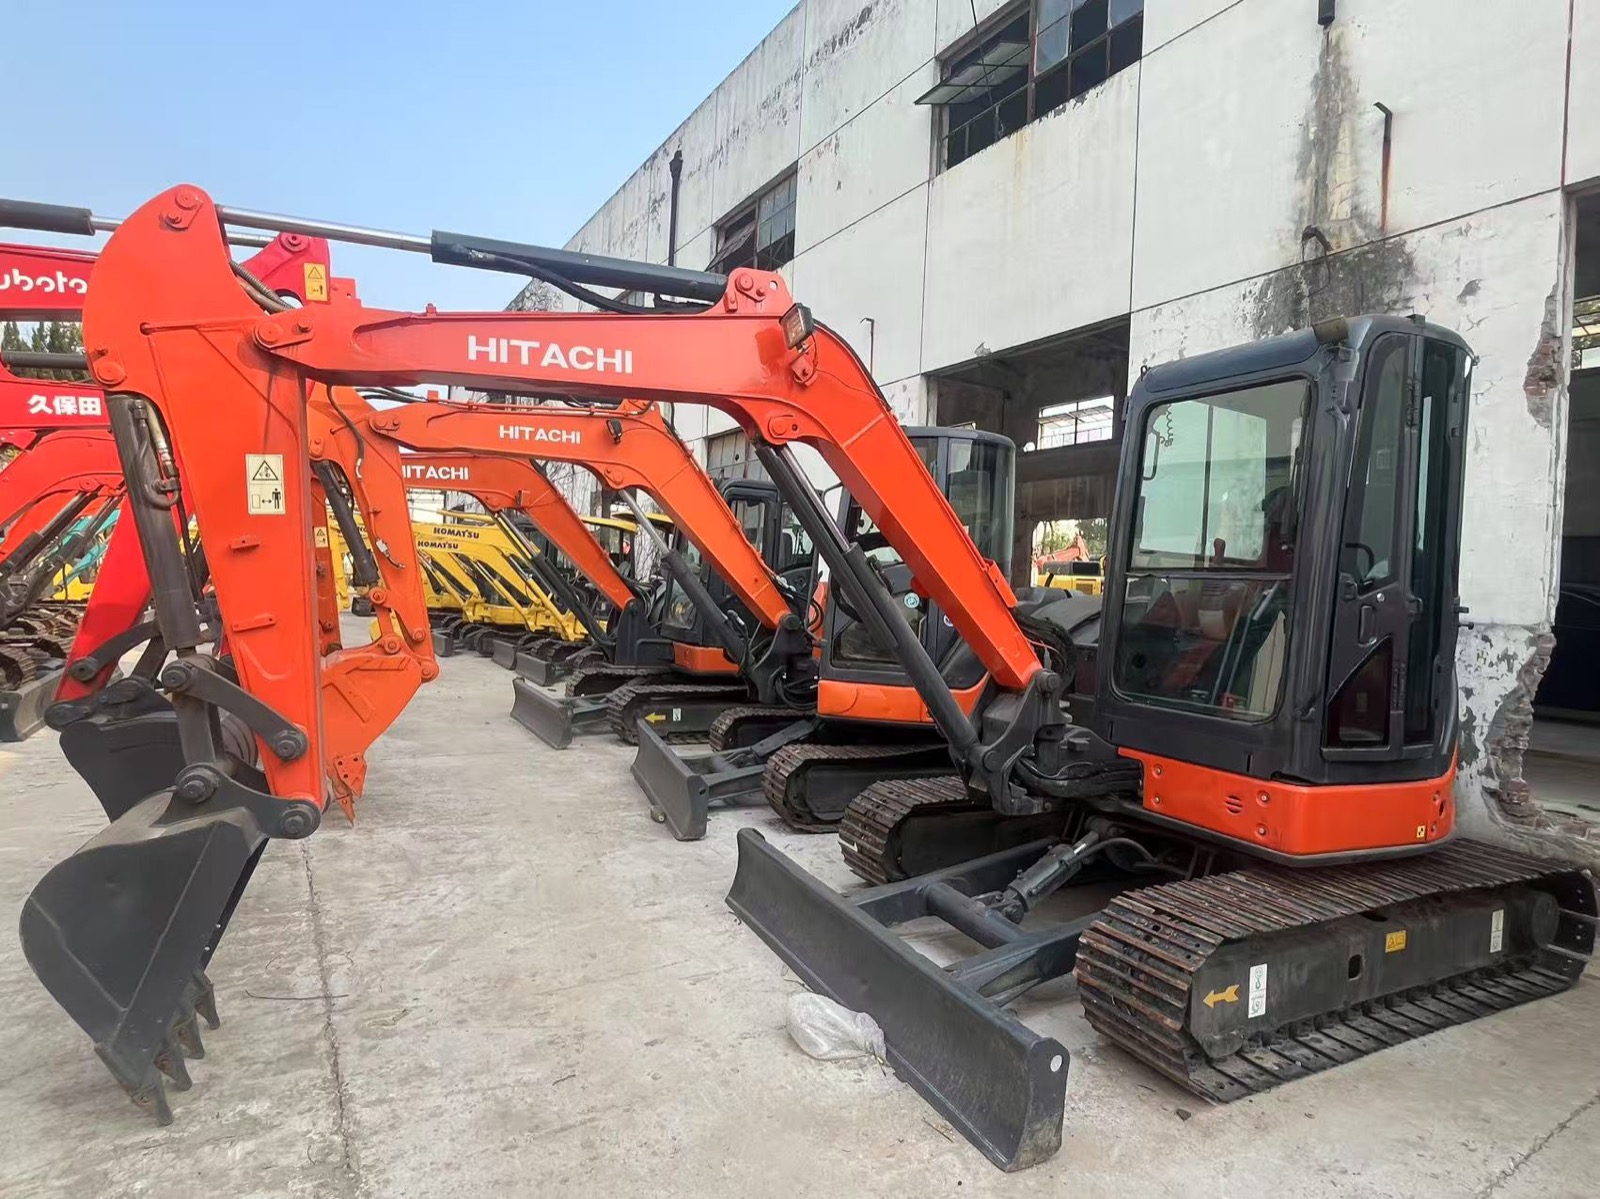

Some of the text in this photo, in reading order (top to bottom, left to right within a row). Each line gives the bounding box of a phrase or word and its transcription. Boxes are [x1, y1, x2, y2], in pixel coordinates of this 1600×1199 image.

[468, 335, 633, 374] HITACHI
[28, 394, 102, 416] 久保田
[499, 424, 581, 444] HITACHI
[433, 527, 480, 539] KOMATSU
[417, 540, 459, 549] KOMATSU
